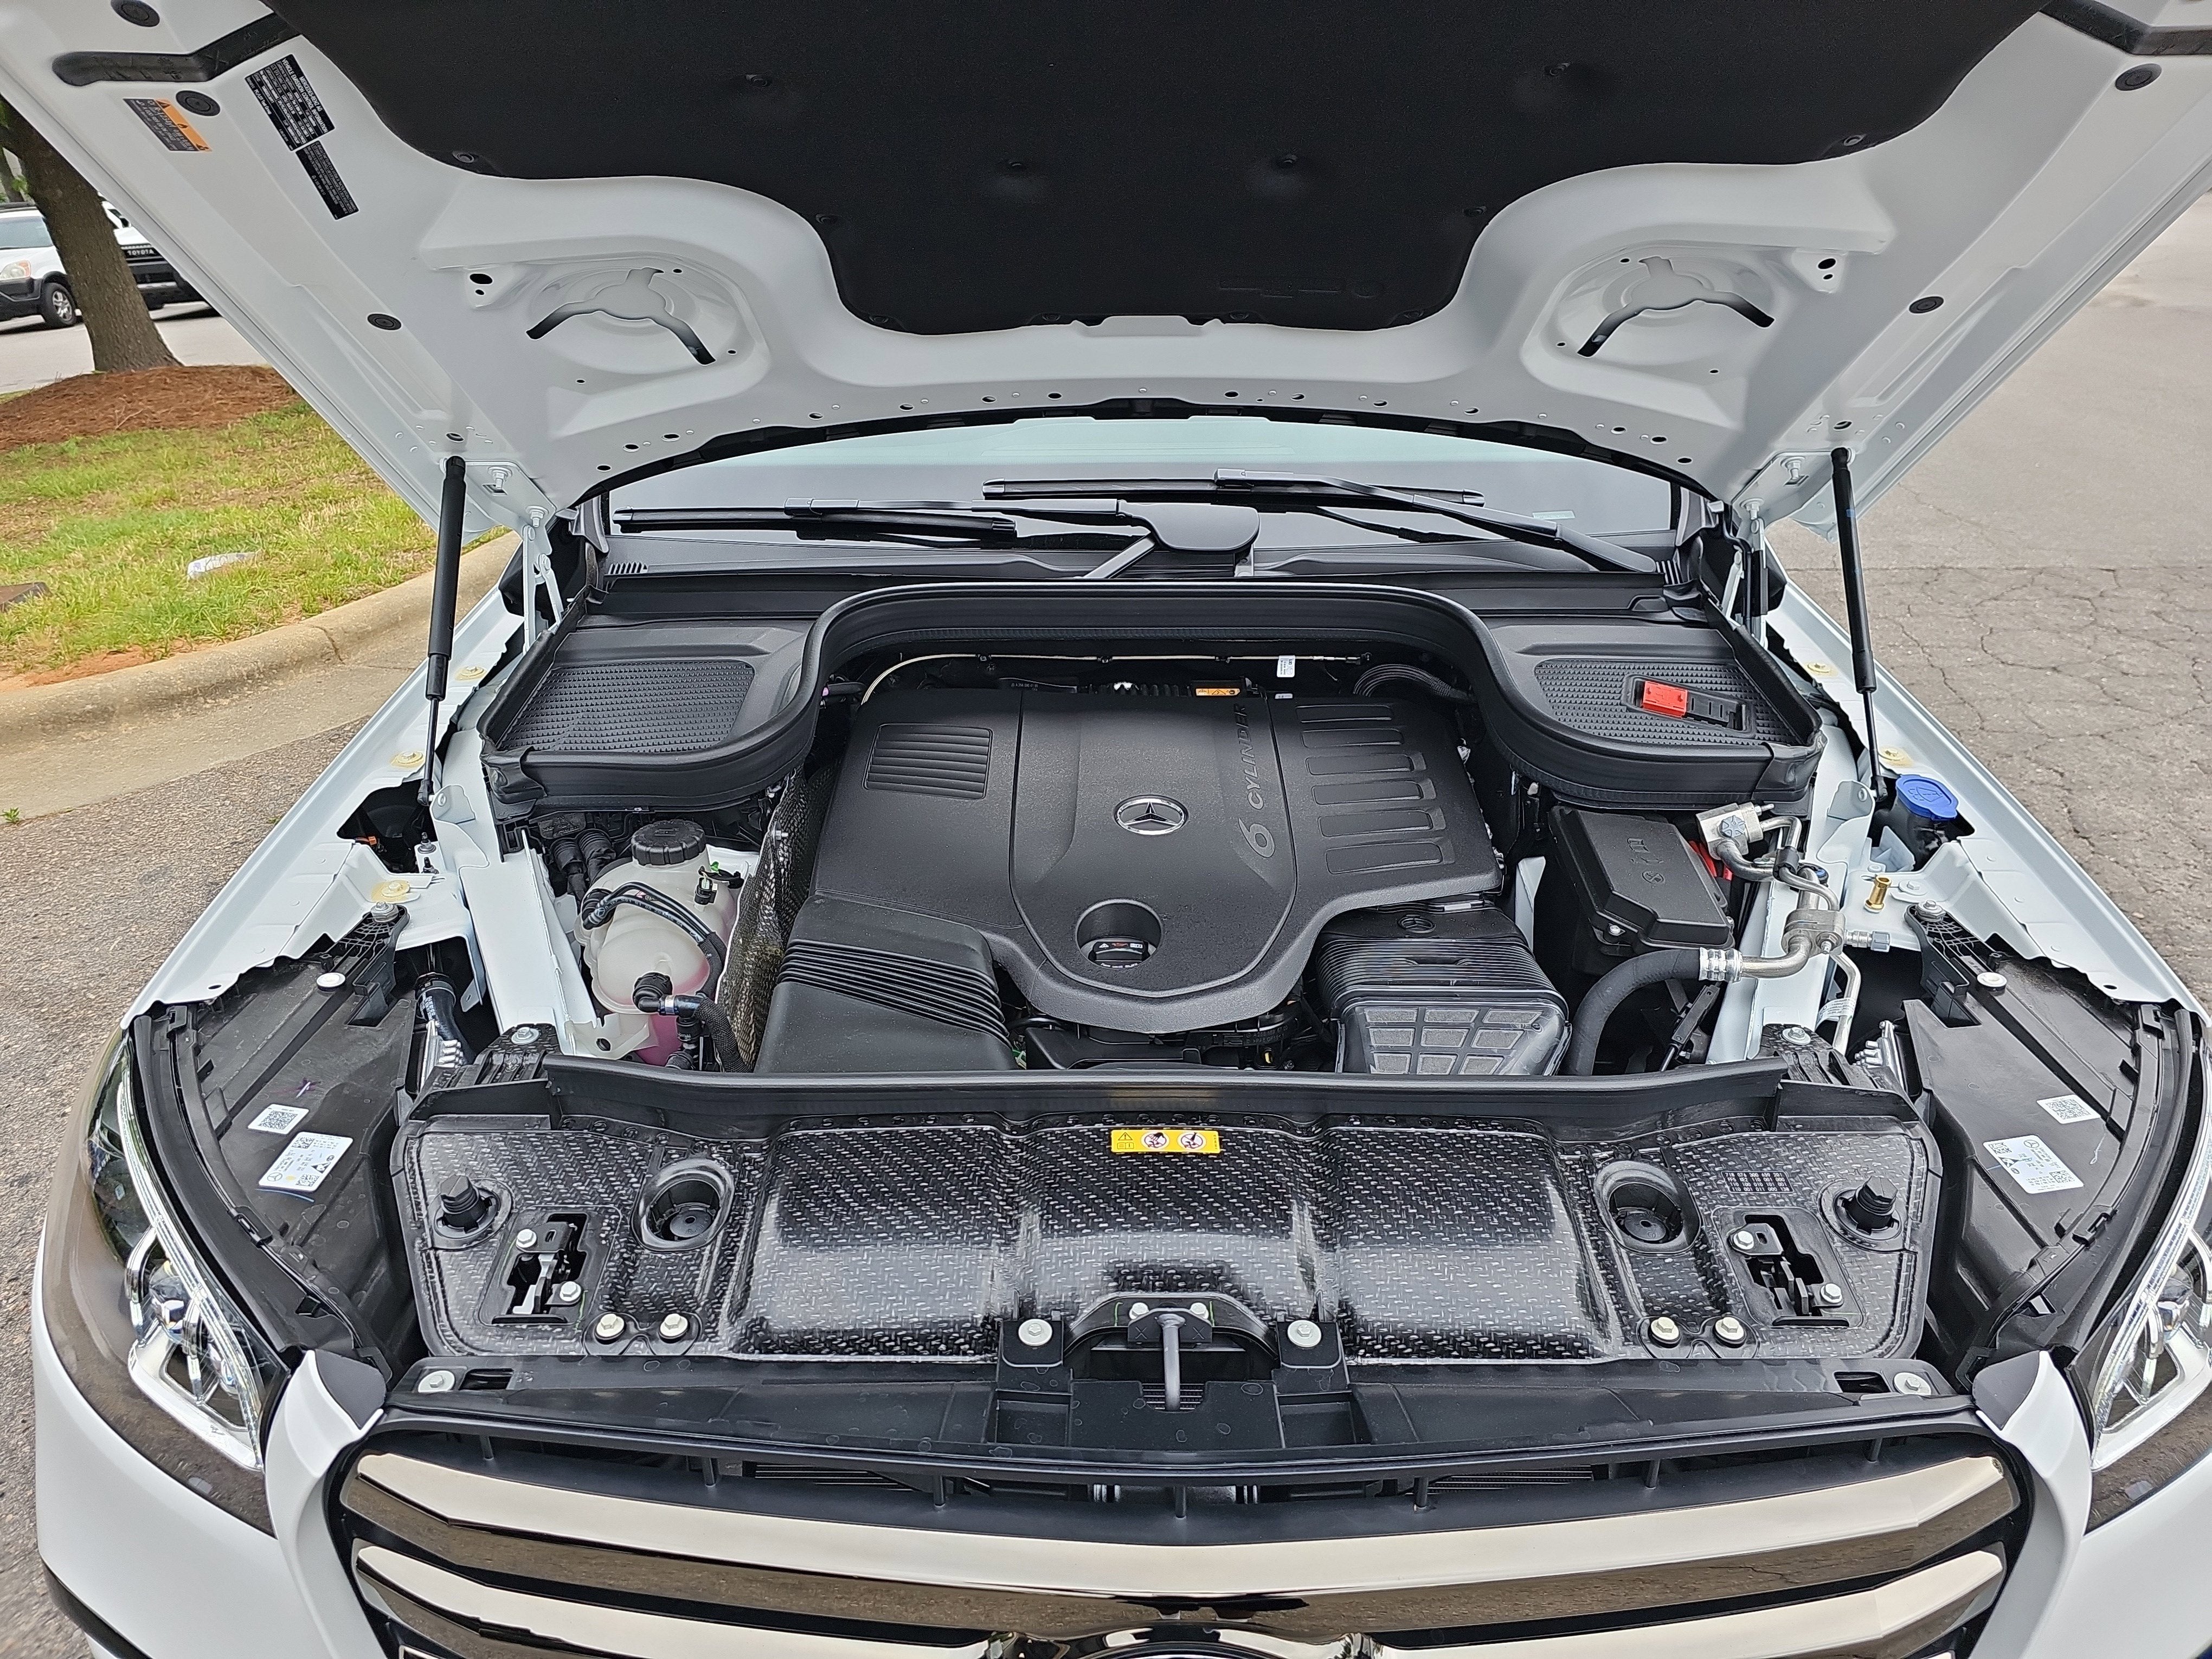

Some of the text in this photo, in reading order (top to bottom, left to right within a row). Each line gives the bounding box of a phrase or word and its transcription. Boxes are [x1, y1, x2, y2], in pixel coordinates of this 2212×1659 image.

[281, 57, 294, 75] VEHICLE
[291, 74, 305, 93] EMISSION
[301, 91, 315, 110] CONTROL
[311, 108, 329, 133] INFORMATION
[299, 75, 319, 106] MERCEDES-BENZ
[1234, 703, 1275, 858] 6 CYLINDER
